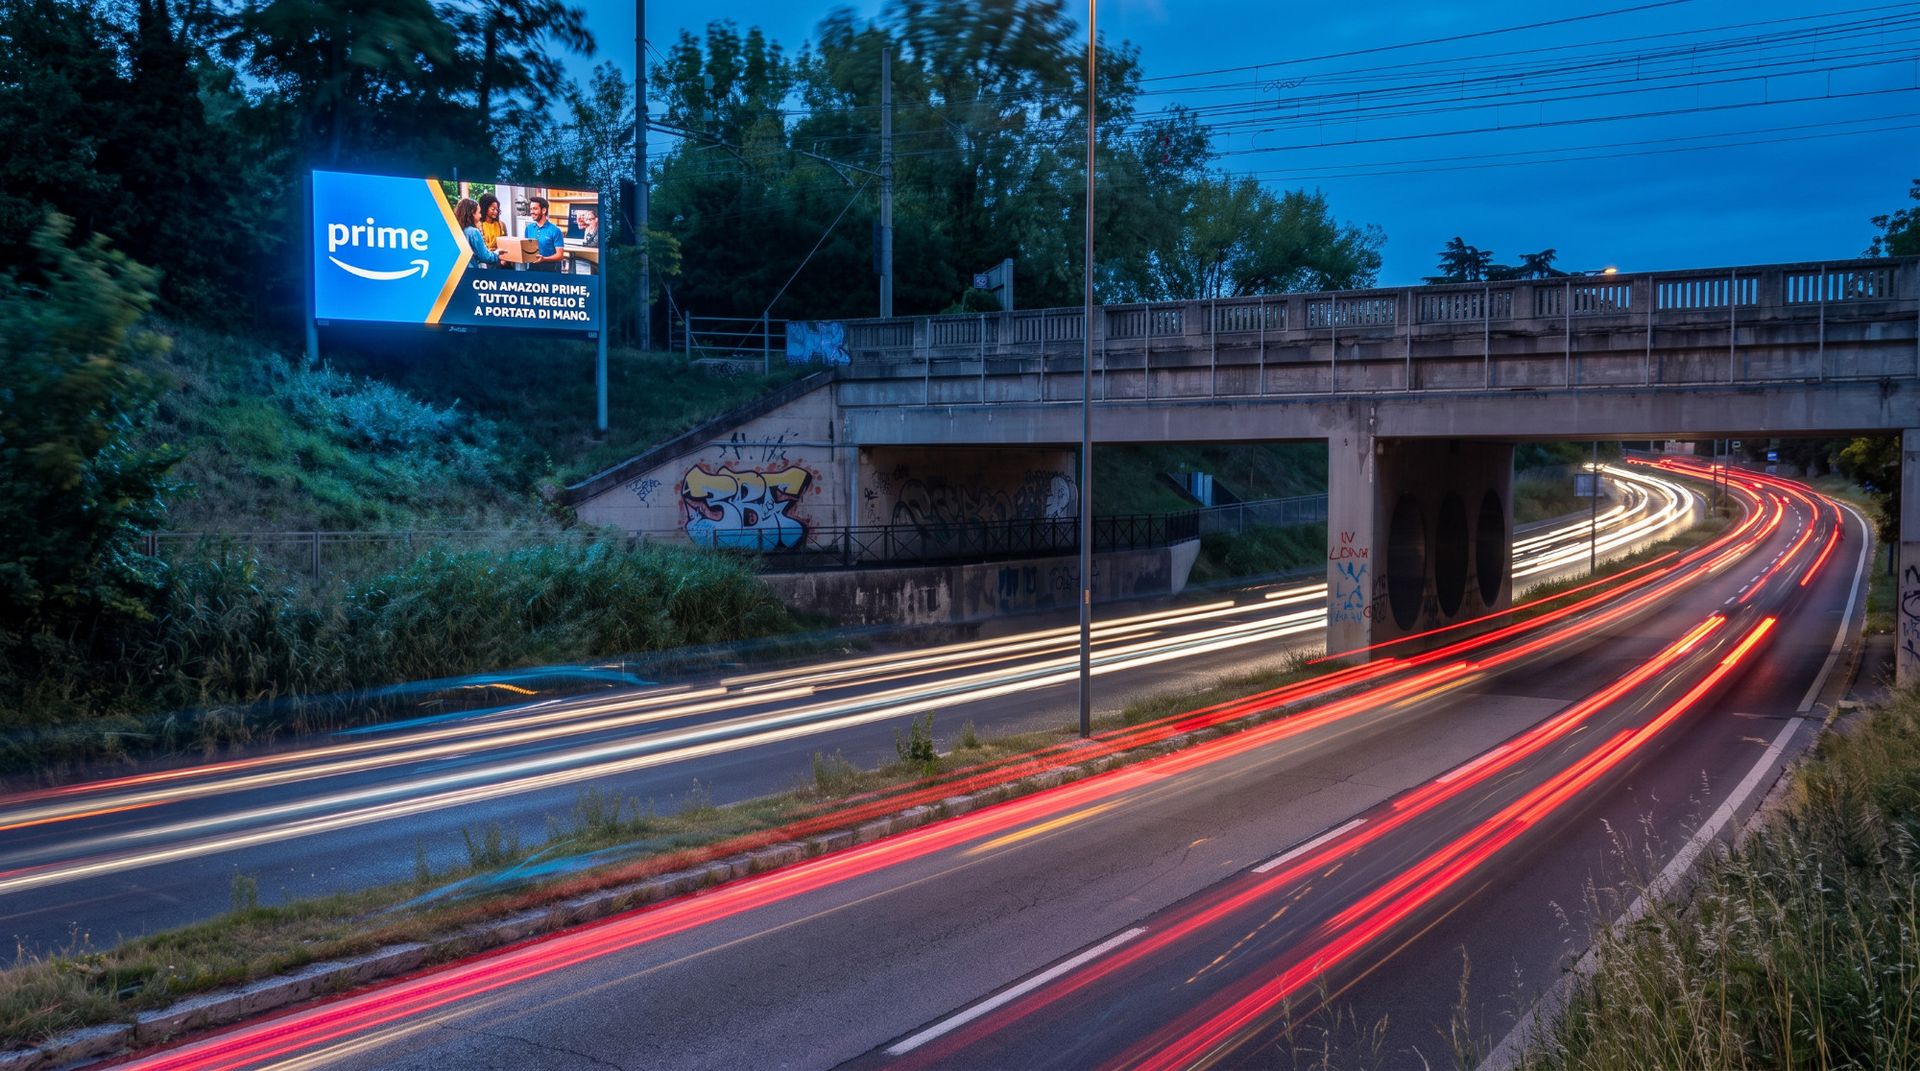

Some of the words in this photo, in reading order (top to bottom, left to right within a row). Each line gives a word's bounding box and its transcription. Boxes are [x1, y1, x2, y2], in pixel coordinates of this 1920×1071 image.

[328, 217, 429, 252] prime
[472, 280, 497, 291] CON
[500, 281, 549, 294] AMAZON
[552, 284, 590, 298] PRIME,
[478, 293, 518, 305] TUTTO
[520, 295, 531, 306] IL
[533, 296, 576, 308] MEGLIO
[474, 306, 483, 316] A
[485, 306, 536, 319] PORTATA
[538, 309, 551, 320] DI
[552, 310, 590, 321] MANO.
